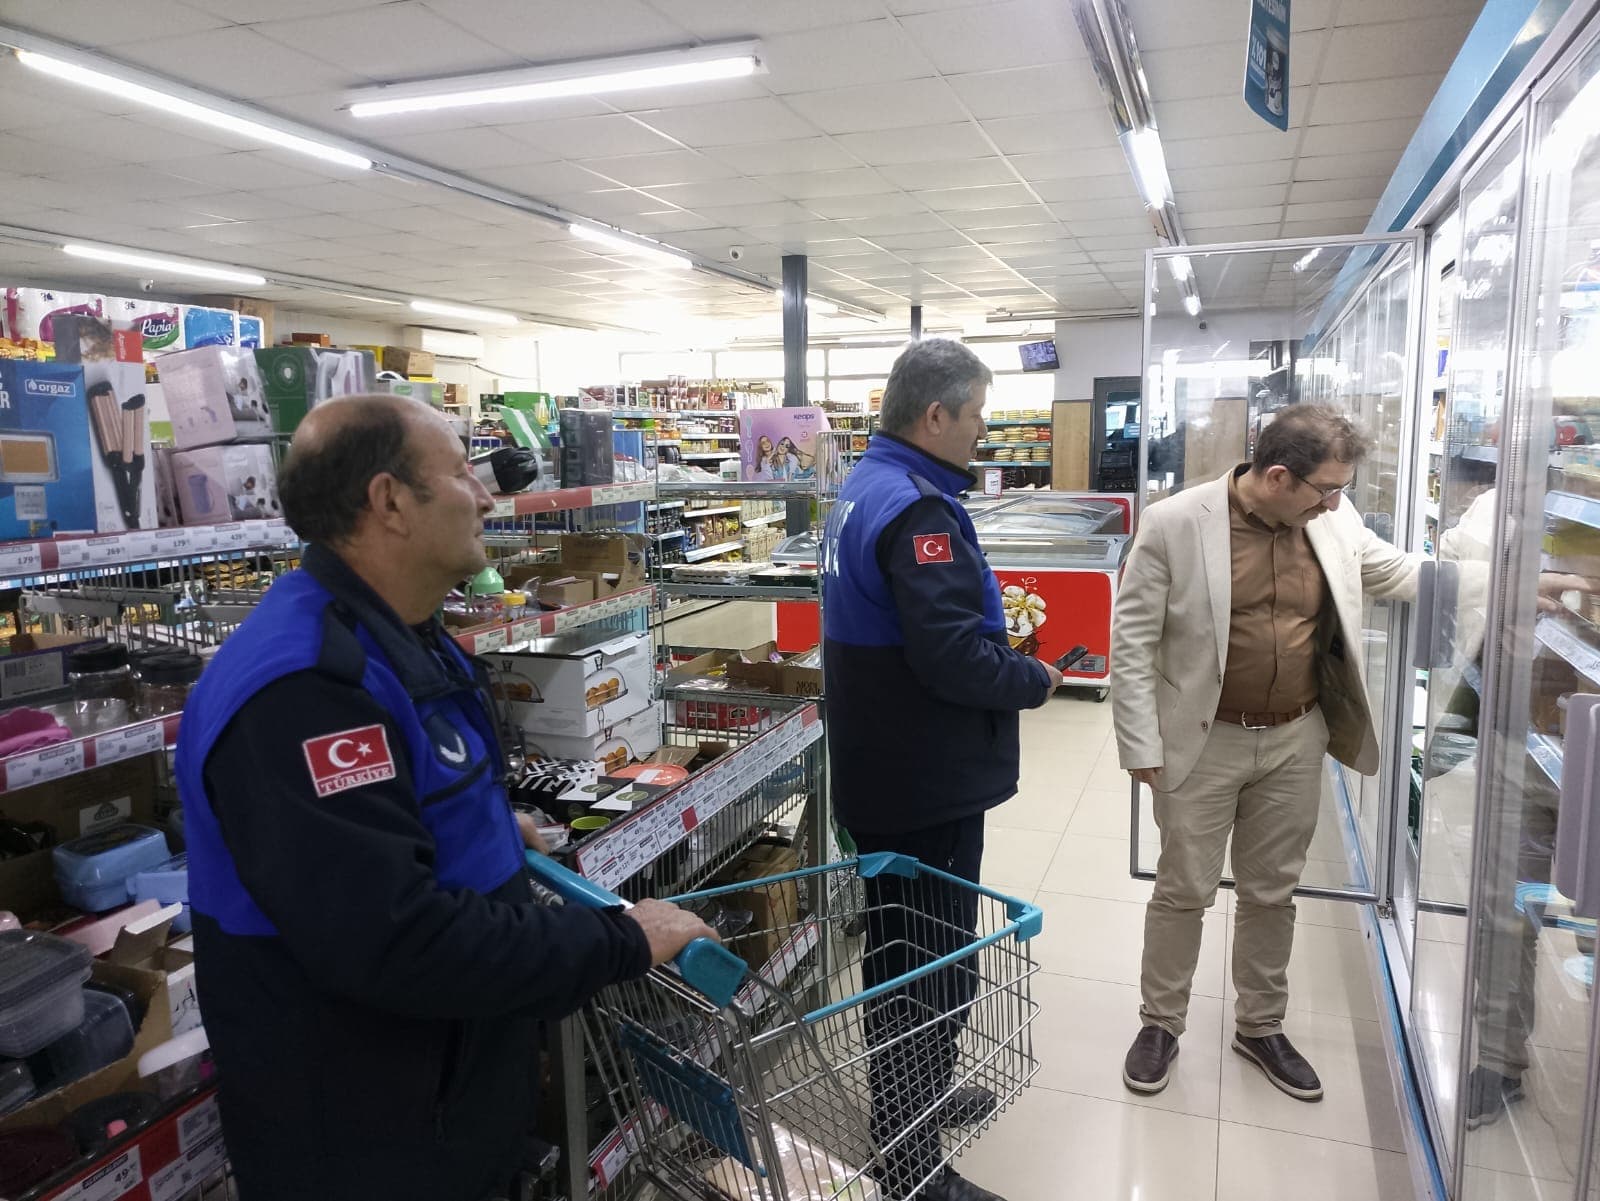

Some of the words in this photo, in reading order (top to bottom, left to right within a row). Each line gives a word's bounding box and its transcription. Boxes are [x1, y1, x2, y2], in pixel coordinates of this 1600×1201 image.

[142, 318, 173, 337] Papia
[38, 383, 71, 394] orgaz
[321, 766, 392, 794] TÜRKİYE
